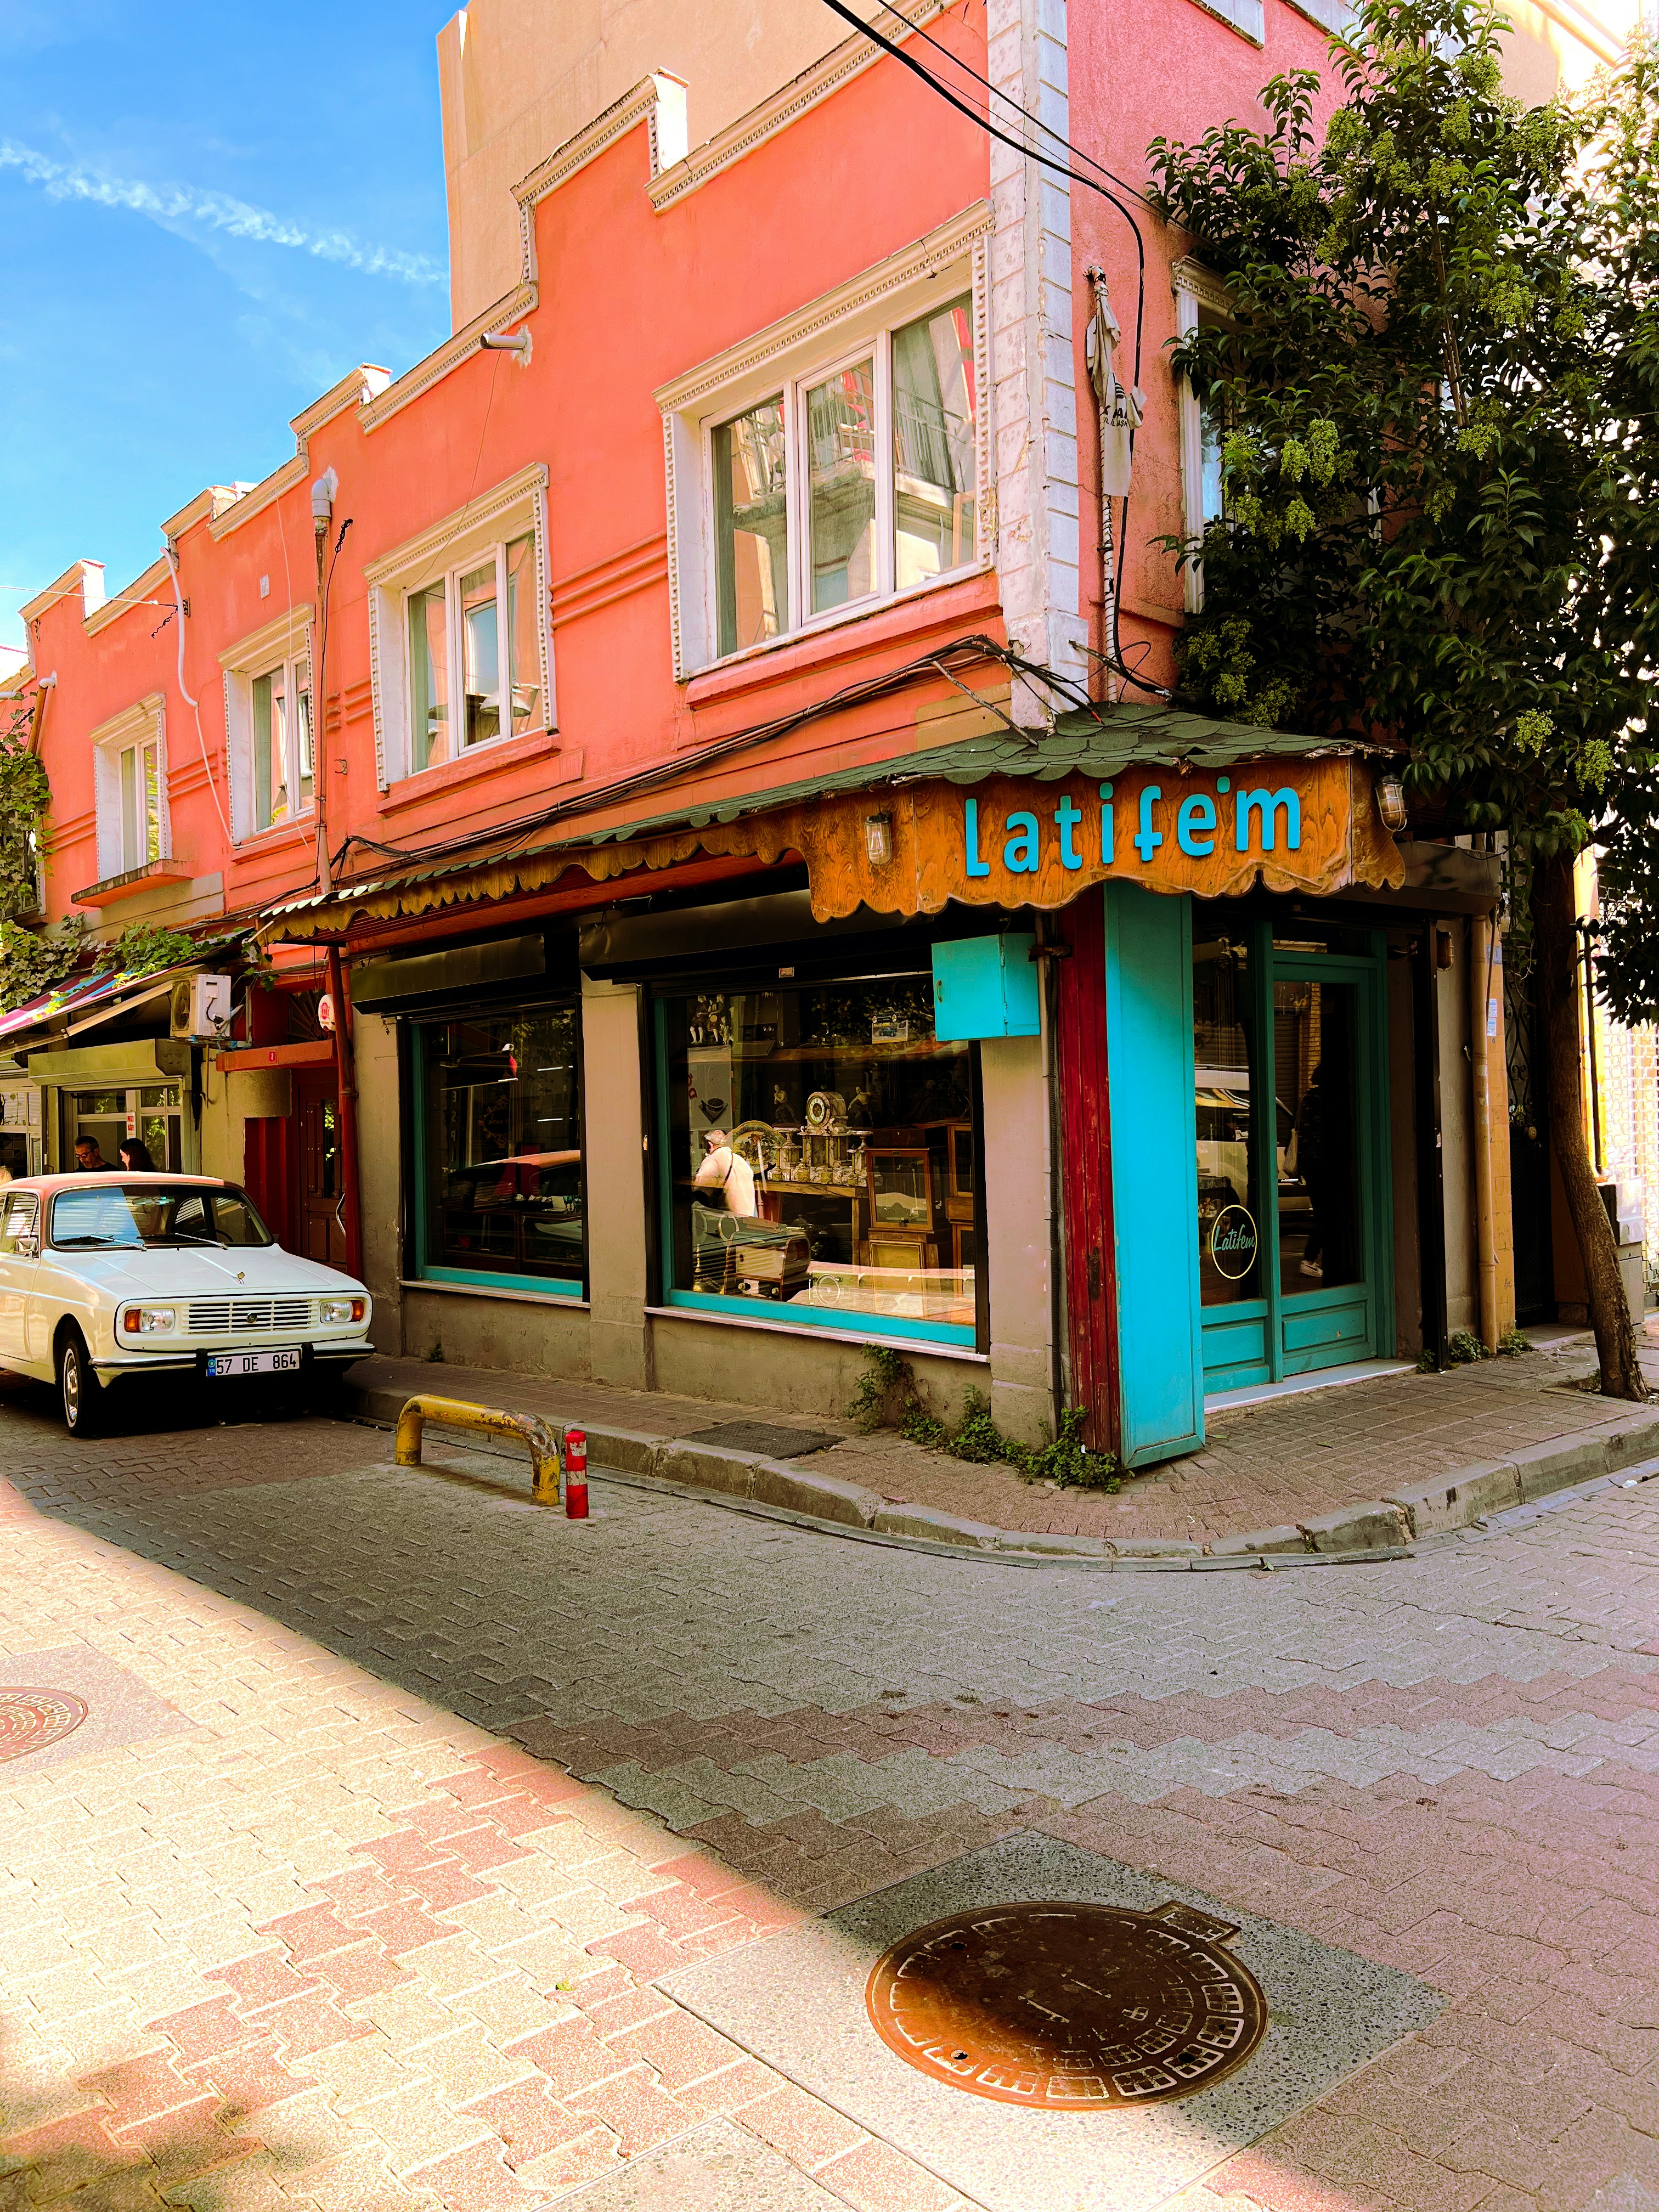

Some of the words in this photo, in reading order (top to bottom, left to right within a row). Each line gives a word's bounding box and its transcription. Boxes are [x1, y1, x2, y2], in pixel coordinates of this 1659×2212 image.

[1213, 1224, 1255, 1251] Latifem
[216, 1359, 233, 1374] 57
[242, 1356, 259, 1372] DE
[273, 1353, 297, 1369] 864
